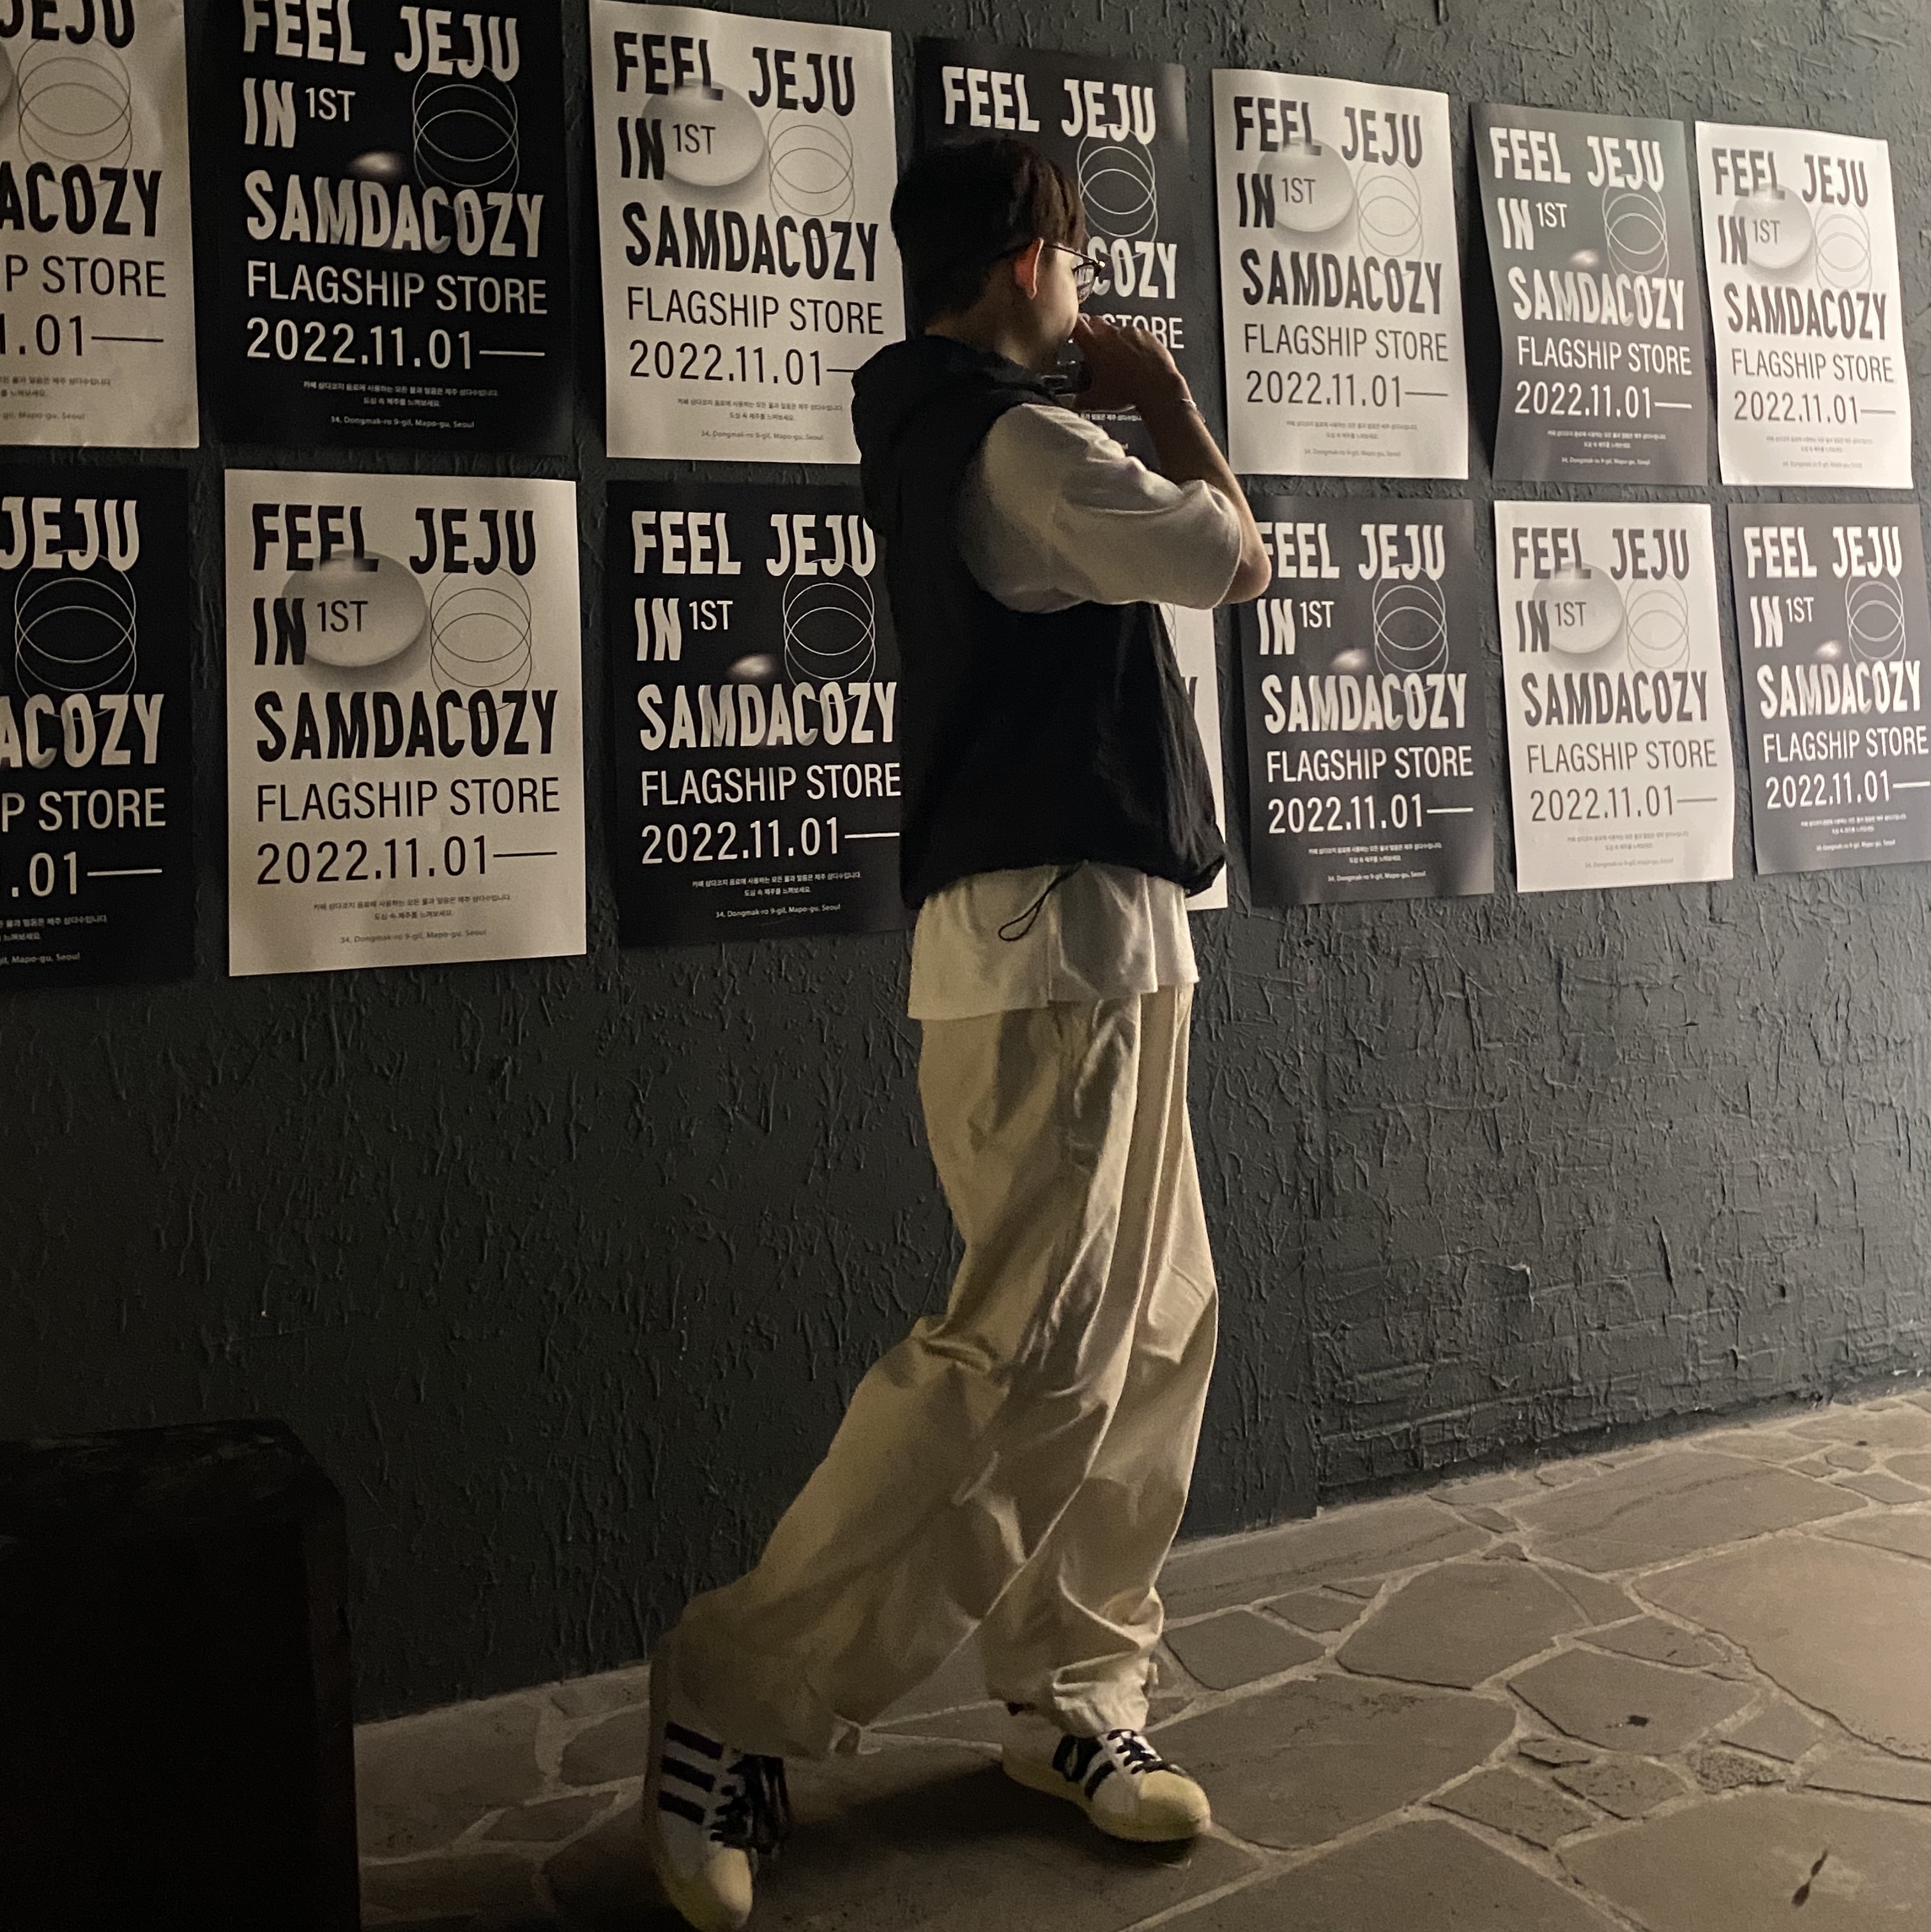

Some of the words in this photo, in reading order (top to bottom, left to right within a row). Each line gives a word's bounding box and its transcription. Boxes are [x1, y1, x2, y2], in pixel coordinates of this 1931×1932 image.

[243, 0, 366, 65] FEEL
[395, 6, 519, 81] JEJU
[614, 31, 723, 101] FEEL
[749, 47, 855, 116] JEJU
[243, 77, 296, 148] IN
[305, 88, 355, 121] 1ST
[942, 66, 1039, 132] FEEL
[1062, 79, 1156, 144] JEJU
[1233, 96, 1322, 156] FEEL
[1341, 107, 1423, 168] JEJU
[618, 116, 665, 180] IN
[673, 123, 715, 154] 1ST
[1489, 126, 1571, 183] FEEL
[1587, 135, 1665, 190] JEJU
[0, 160, 162, 237] ACOZY
[1237, 172, 1276, 228] IN
[1282, 177, 1315, 204] 1ST
[1712, 148, 1785, 201] FEEL
[1802, 153, 1869, 208] JEJU
[244, 170, 544, 257] SAMDACOZY
[1497, 197, 1534, 250] IN
[1536, 203, 1567, 228] 1ST
[1718, 215, 1748, 266] IN
[1752, 220, 1781, 245] 1ST
[622, 202, 878, 282] SAMDACOZY
[42, 256, 166, 297] STORE
[248, 261, 425, 308] FLAGSHIP
[436, 275, 547, 314] STORE
[1240, 249, 1442, 314] SAMDACOZY
[1508, 266, 1685, 331] SAMDACOZY
[628, 287, 779, 328] FLAGSHIP
[790, 298, 883, 334] STORE
[1725, 282, 1886, 340] SAMDACOZY
[247, 317, 471, 370] 2022.11.01
[629, 340, 820, 386] 2022.11.01
[1245, 323, 1367, 358] FLAGSHIP
[1376, 329, 1449, 362] STORE
[1517, 335, 1622, 371] FLAGSHIP
[1628, 342, 1692, 376] STORE
[1732, 348, 1826, 379] FLAGSHIP
[1833, 354, 1893, 383] STORE
[1246, 370, 1400, 408] 2022.11.01
[1515, 380, 1651, 419] 2022.11.01
[1734, 390, 1858, 424] 2022.11.01
[0, 496, 139, 571] JEJU
[252, 503, 379, 572] FEEL
[409, 508, 537, 576] JEJU
[632, 510, 741, 574] FEEL
[766, 514, 876, 577] JEJU
[1358, 524, 1446, 581] JEJU
[1512, 526, 1592, 579] FEEL
[1610, 528, 1690, 580] JEJU
[1743, 526, 1817, 578] FEEL
[1833, 526, 1902, 578] JEJU
[253, 597, 307, 665] IN
[317, 600, 369, 632] 1ST
[634, 598, 682, 661] IN
[689, 600, 733, 630] 1ST
[1256, 599, 1296, 656] IN
[1300, 601, 1334, 629] 1ST
[1515, 600, 1550, 653] IN
[1554, 601, 1587, 627] 1ST
[1750, 595, 1783, 648] IN
[1786, 596, 1814, 622] 1ST
[637, 681, 897, 751] SAMDACOZY
[1261, 672, 1467, 734] SAMDACOZY
[1522, 670, 1707, 726] SAMDACOZY
[1757, 659, 1921, 719] SAMDACOZY
[0, 693, 164, 769] ACOZY
[255, 689, 558, 762] SAMDACOZY
[1763, 730, 1859, 763] FLAGSHIP
[1865, 724, 1929, 756] STORE
[641, 767, 797, 806] FLAGSHIP
[806, 762, 901, 800] STORE
[1267, 747, 1387, 783] FLAGSHIP
[1394, 745, 1473, 779] STORE
[1527, 740, 1637, 774] FLAGSHIP
[1647, 739, 1718, 769] STORE
[38, 788, 166, 831] STORE
[258, 780, 438, 823] FLAGSHIP
[450, 777, 560, 815] STORE
[1268, 793, 1422, 834] 2022.11.01
[1530, 784, 1675, 822] 2022.11.01
[1765, 769, 1891, 809] 2022.11.01
[257, 834, 485, 885] 2022.11.01
[641, 816, 837, 864] 2022.11.01
